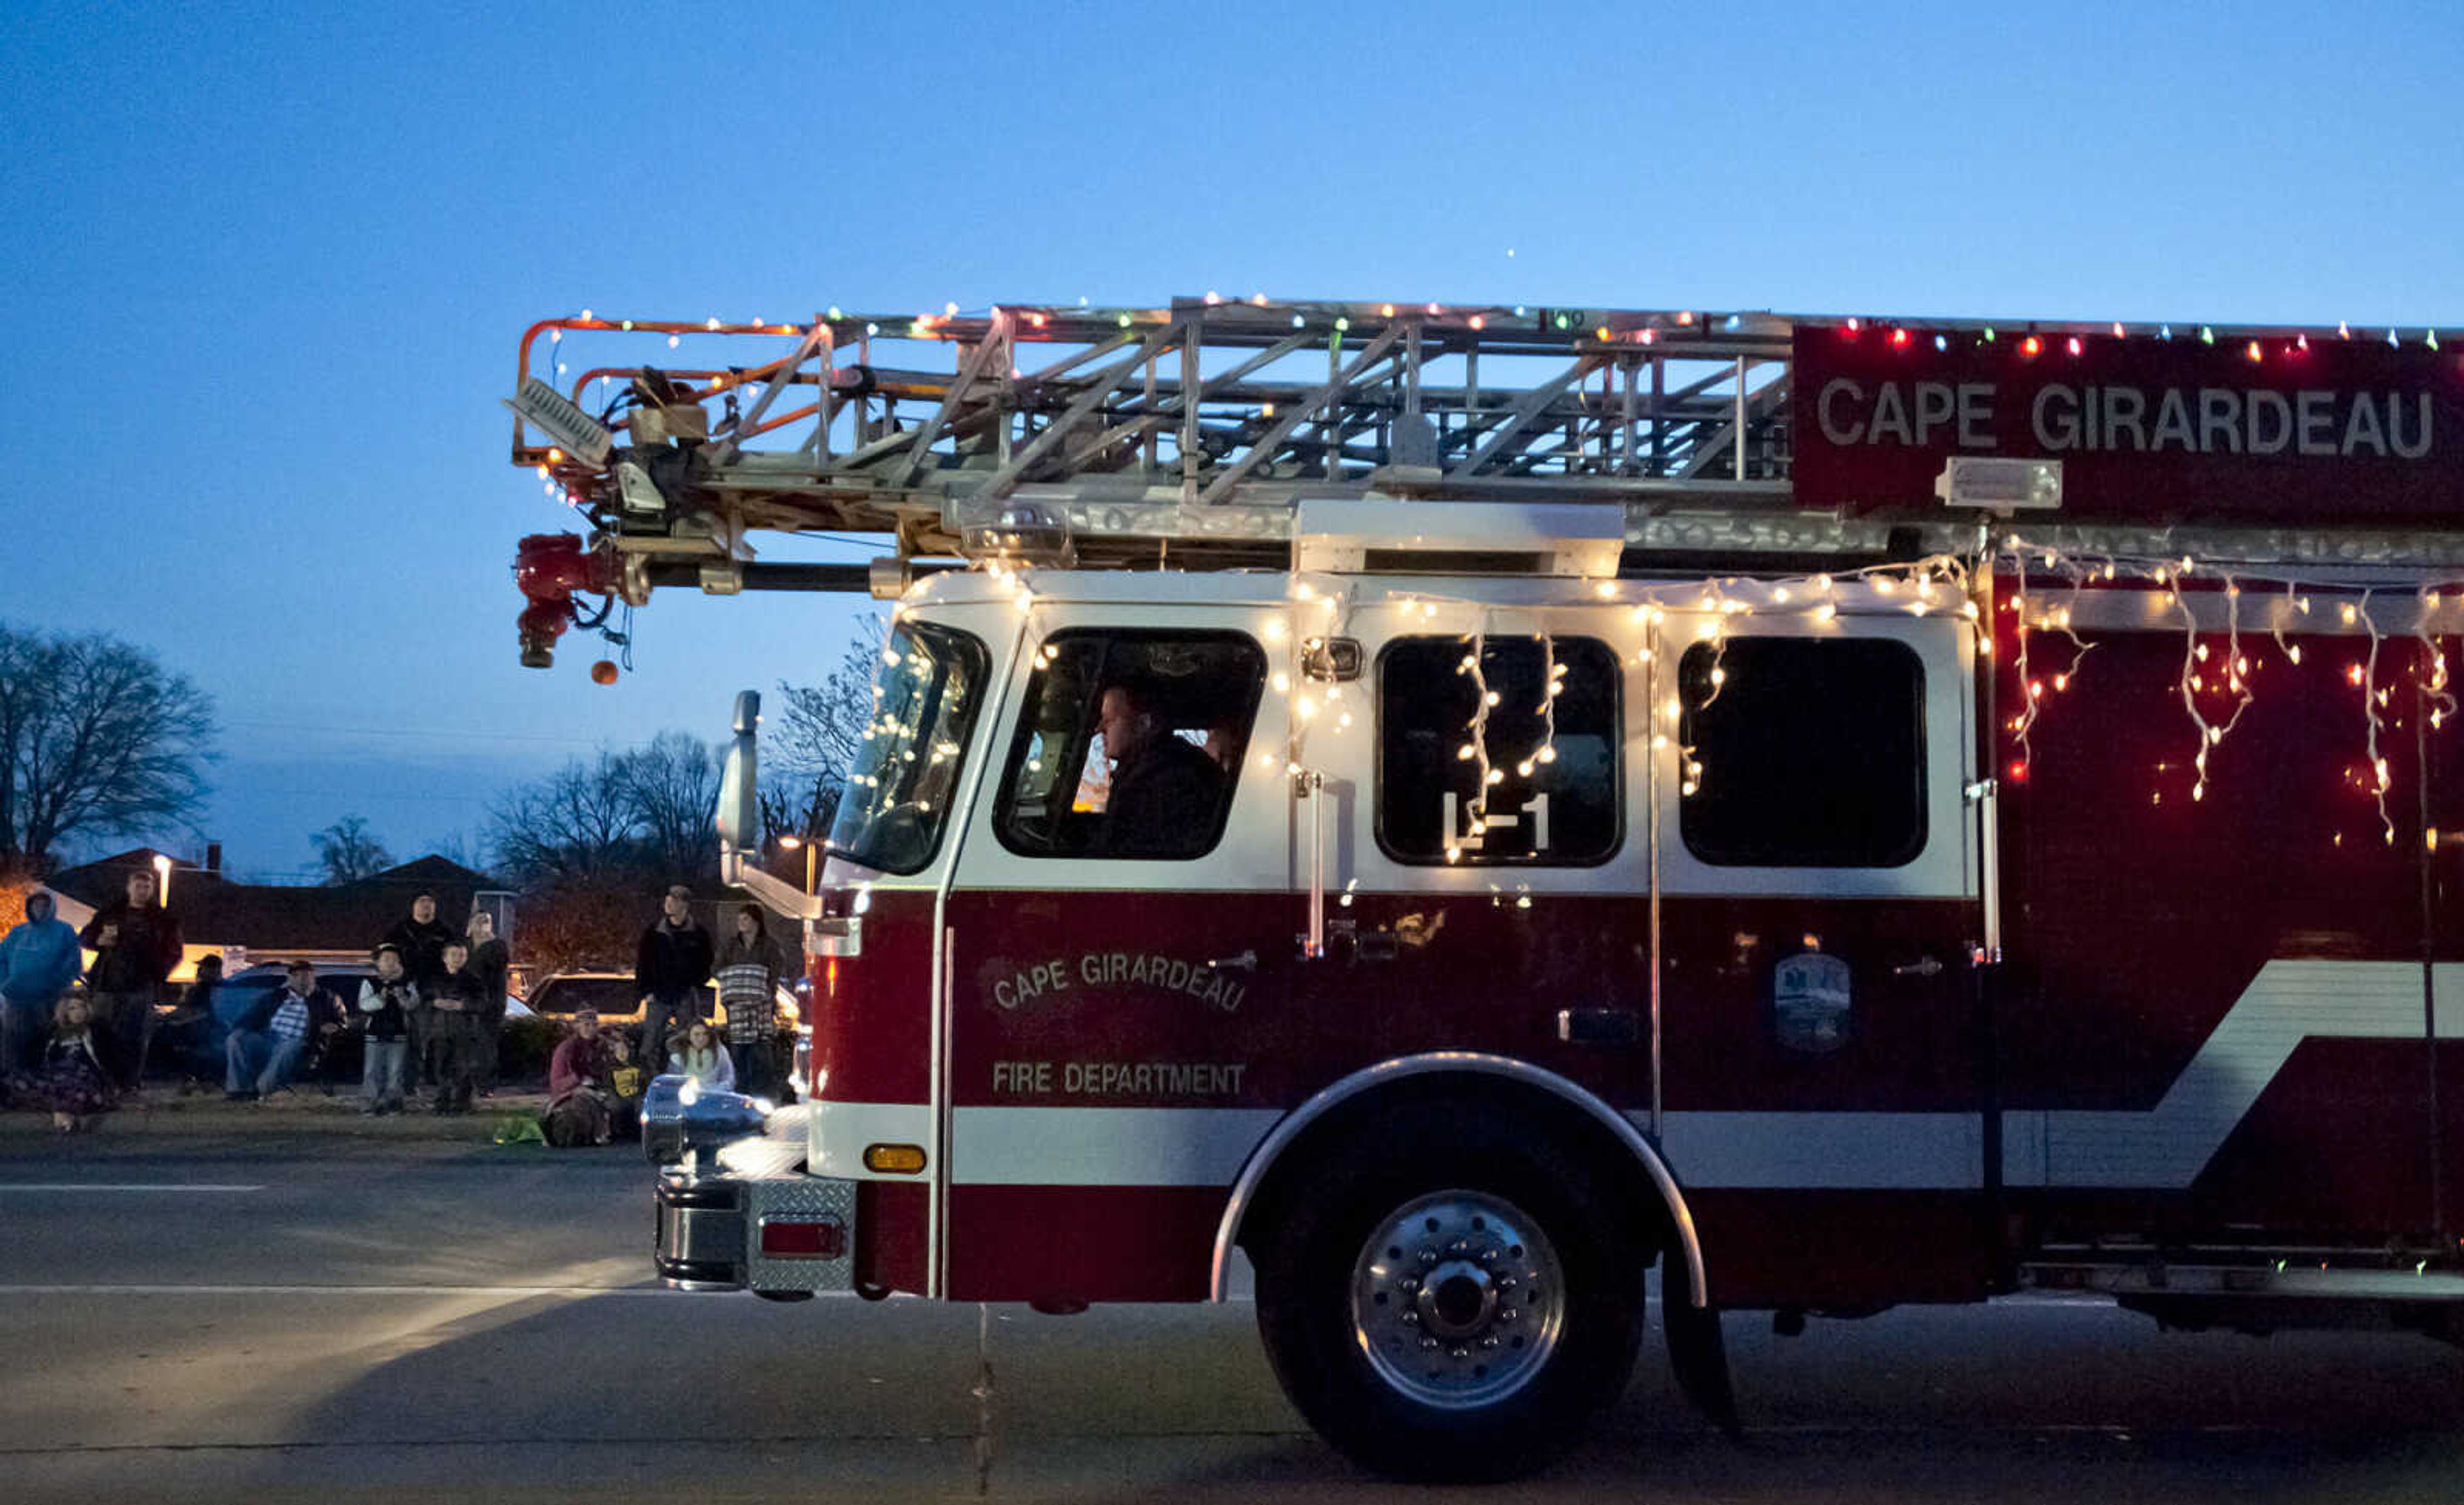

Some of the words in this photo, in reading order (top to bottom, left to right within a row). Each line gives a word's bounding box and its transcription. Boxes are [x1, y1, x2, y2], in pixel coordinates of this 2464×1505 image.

[1818, 377, 1997, 447] CAPE
[2032, 383, 2433, 458] GIRARDEAU
[1443, 792, 1548, 850] L-1
[994, 961, 1070, 1009] CAPE
[1081, 953, 1245, 1011] GIRARDEAU
[993, 1062, 1052, 1093] FIRE
[1065, 1062, 1245, 1094] DEPARTMENT
